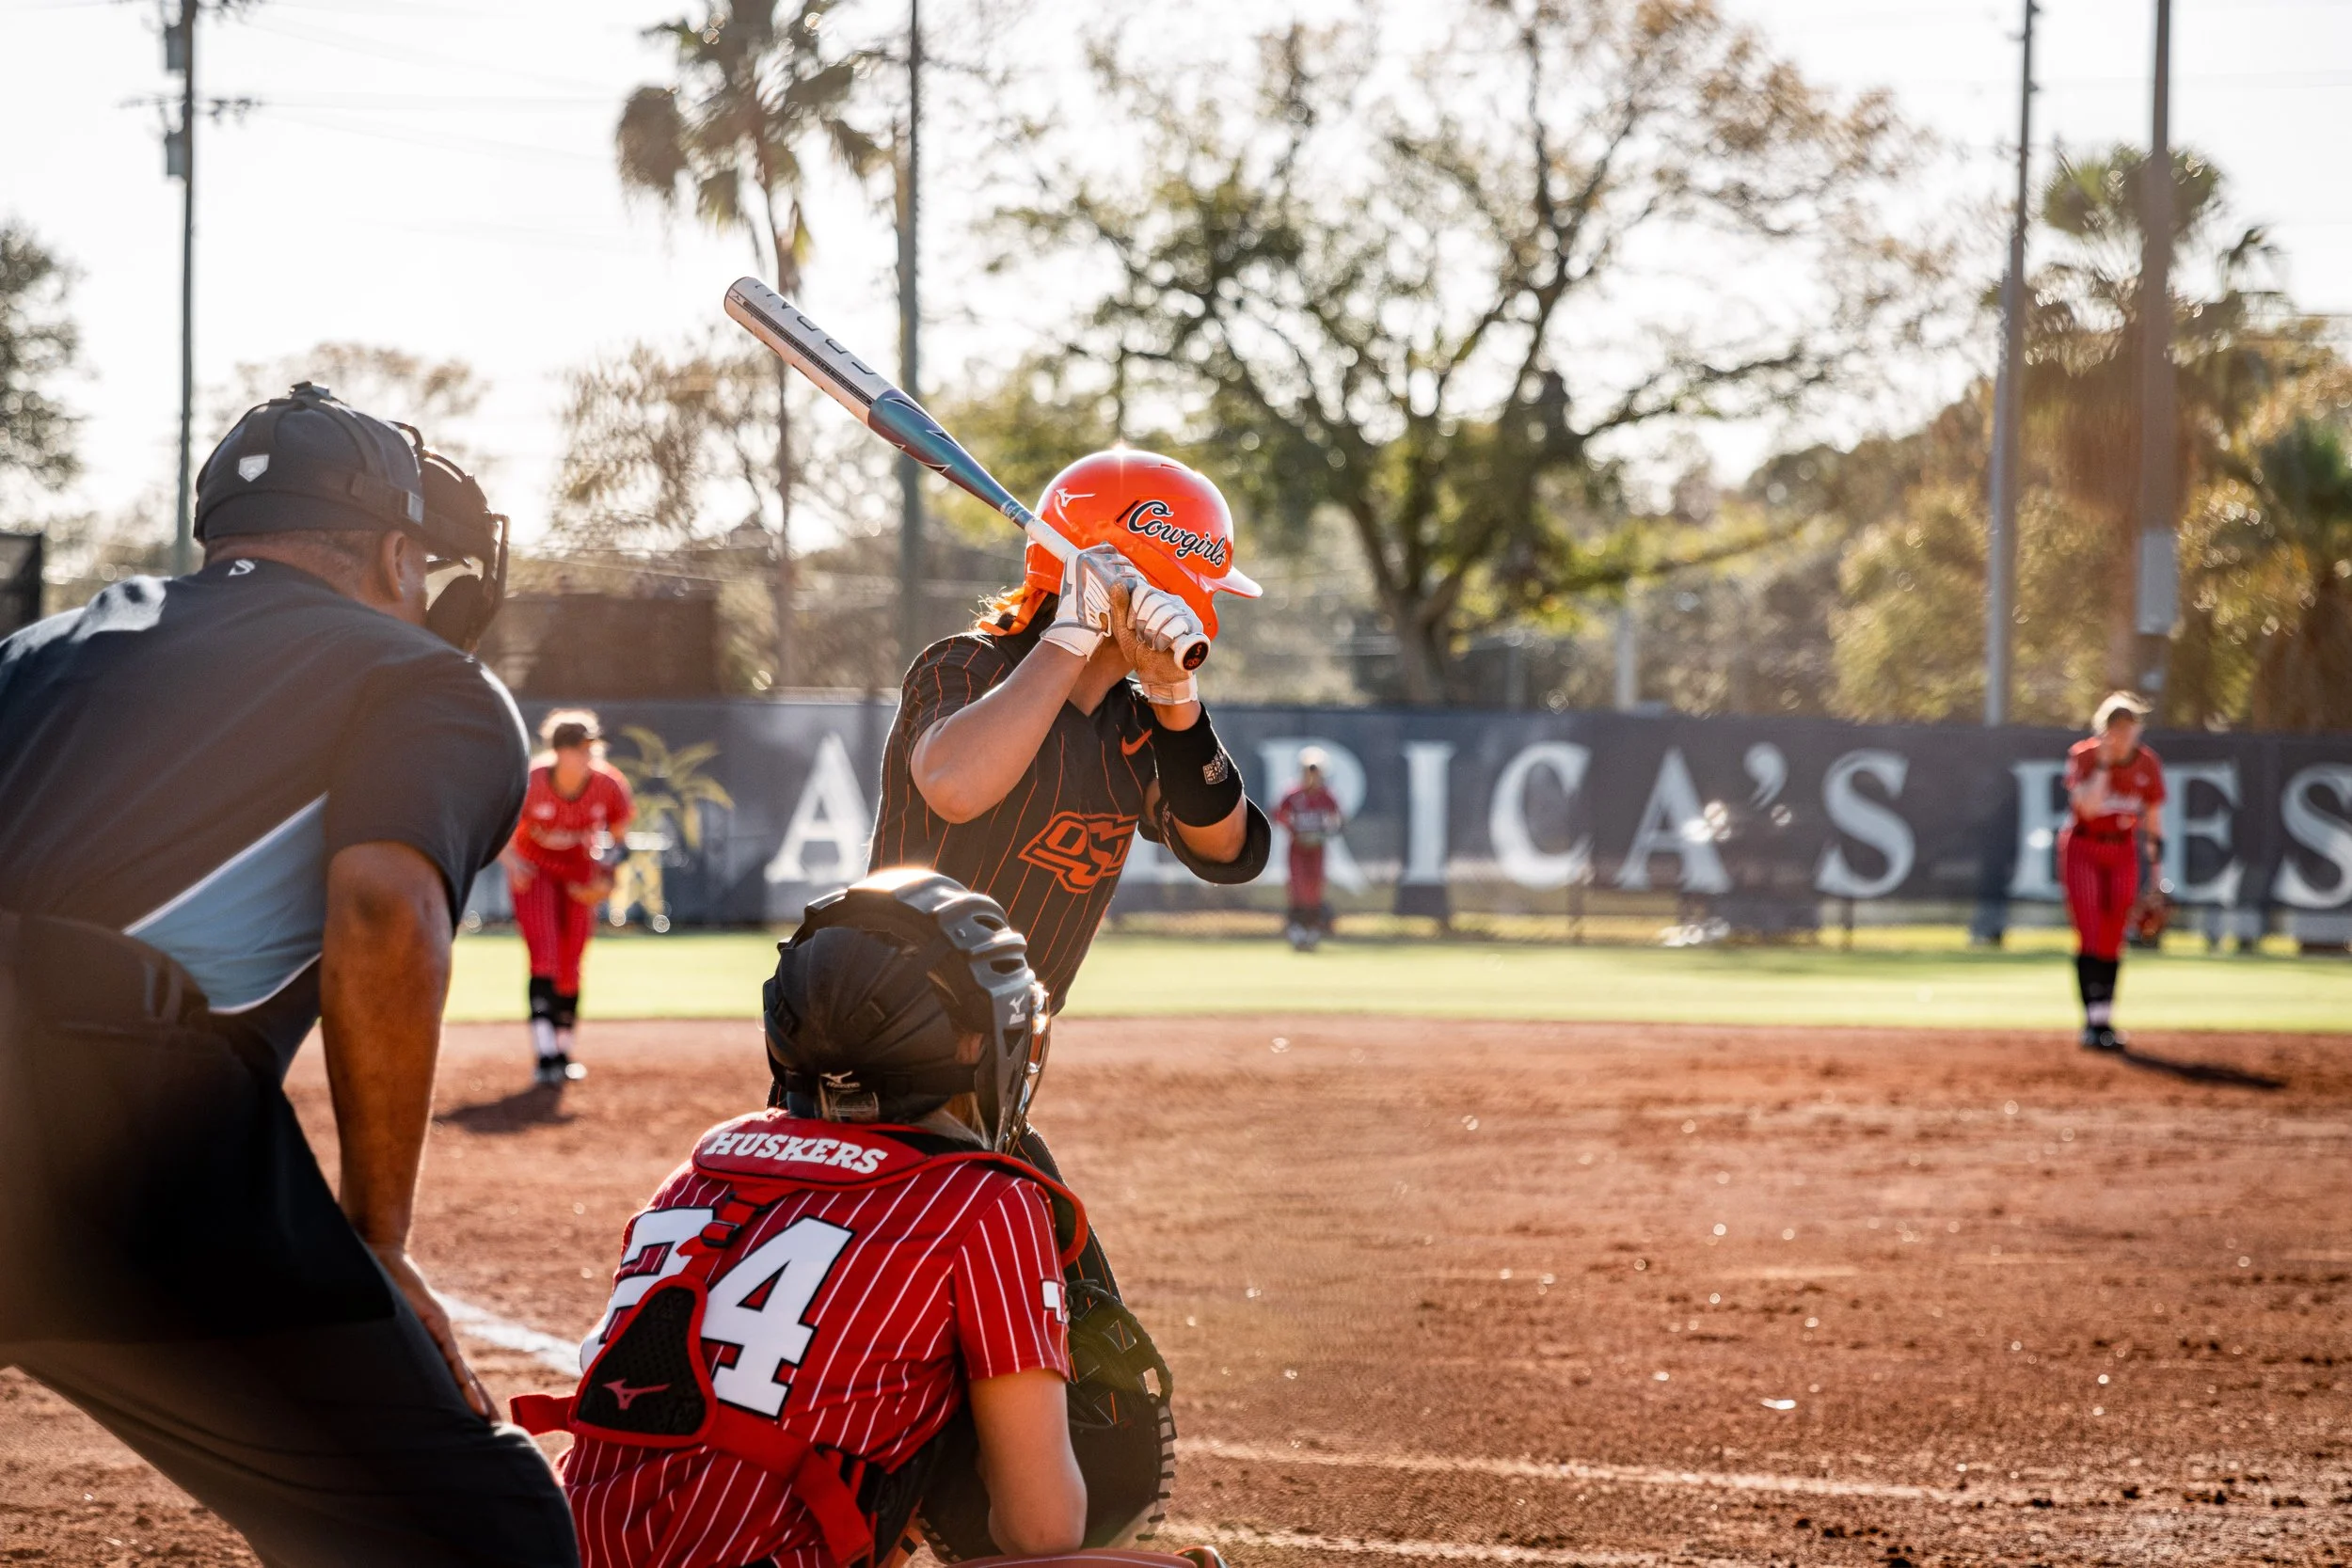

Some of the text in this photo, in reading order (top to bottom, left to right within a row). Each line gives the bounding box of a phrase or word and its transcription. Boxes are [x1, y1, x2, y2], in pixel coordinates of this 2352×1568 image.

[1127, 499, 1227, 567] Cowgirls
[764, 730, 1915, 898] ARICA'S
[704, 1132, 888, 1174] HUSKERS
